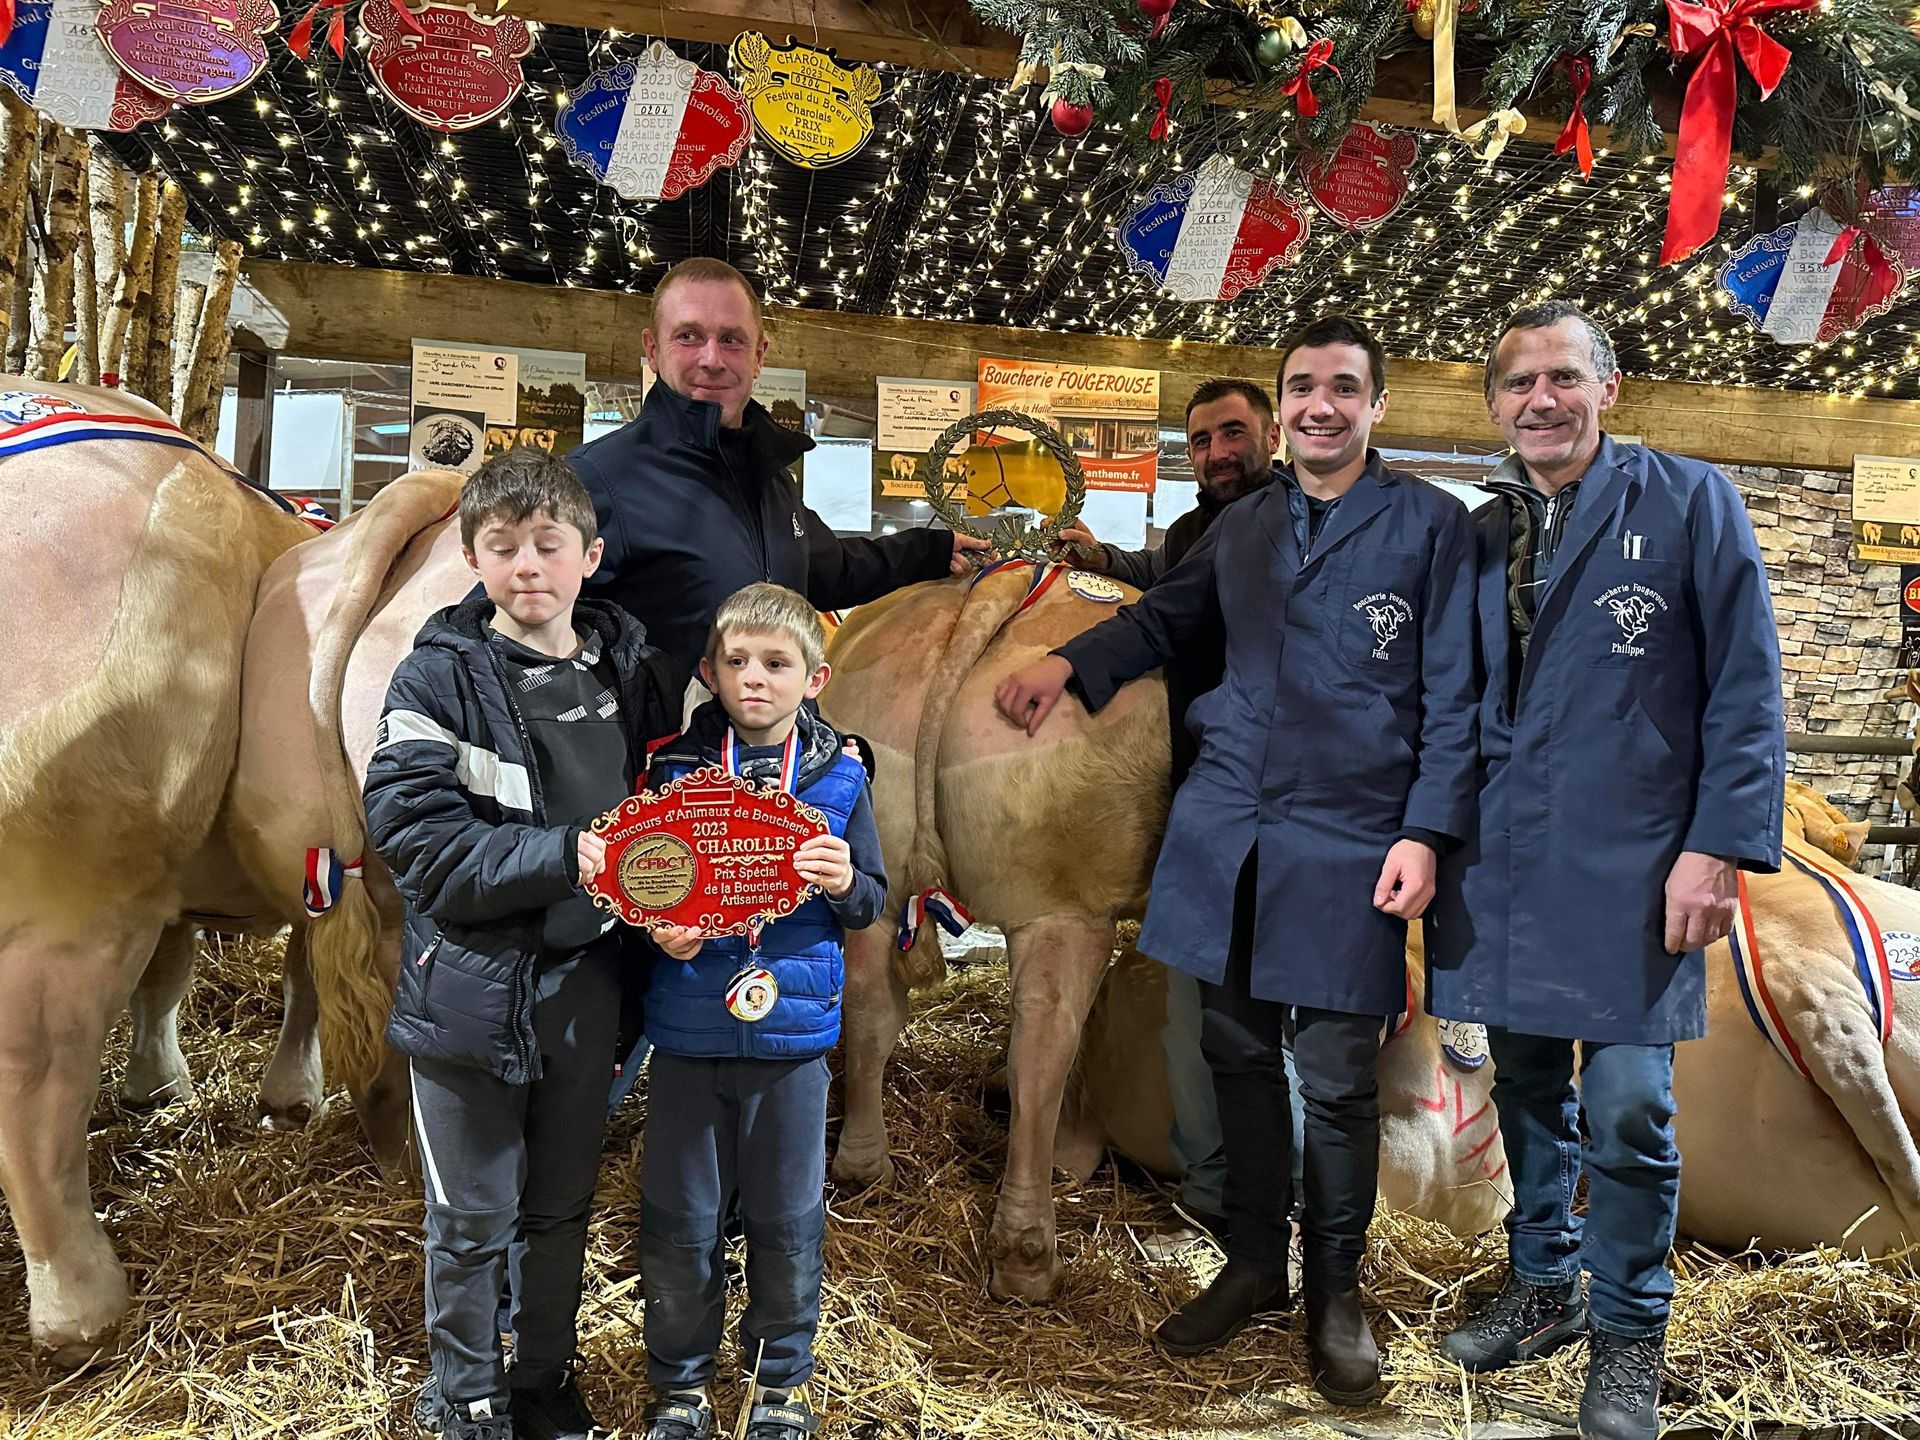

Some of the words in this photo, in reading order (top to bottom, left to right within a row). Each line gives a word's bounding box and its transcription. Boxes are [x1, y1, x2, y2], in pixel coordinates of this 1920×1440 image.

[415, 13, 489, 38] HAROLLES
[434, 25, 462, 37] 2023
[128, 19, 175, 34] Festival
[178, 23, 195, 34] du
[199, 26, 239, 52] Boeuf
[154, 32, 212, 51] Charolais
[135, 40, 160, 52] Prix
[398, 50, 440, 66] Festival
[442, 53, 458, 63] du
[461, 55, 496, 78] Boeuf
[420, 62, 473, 78] Charolais
[776, 53, 847, 82] CHAROLLES
[160, 67, 205, 84] BOEUF
[640, 73, 673, 86] 2023
[800, 66, 824, 79] 2023
[404, 72, 426, 84] Prix
[427, 75, 488, 91] d'Excellence
[795, 76, 821, 89] 0204
[397, 83, 444, 97] Médaille
[446, 87, 494, 104] d'Argent
[427, 98, 465, 111] BOEUF
[577, 94, 619, 126] Festival
[622, 91, 638, 103] du
[641, 88, 679, 101] Boeuf
[681, 92, 733, 129] Charolais
[640, 106, 669, 115] 0204
[765, 90, 803, 104] Festival
[806, 93, 819, 103] du
[822, 99, 853, 124] Boeuf
[785, 102, 832, 123] Charolais
[633, 118, 674, 129] BOEUF
[794, 117, 822, 133] PRIX
[619, 129, 660, 140] Médaille
[779, 125, 836, 148] NAISSEUR
[599, 140, 629, 151] Grand
[631, 140, 651, 151] Prix
[653, 140, 707, 152] d'Honneur
[611, 151, 693, 165] CHAROLLES
[1138, 206, 1178, 237] Festival
[1181, 202, 1195, 213] du
[1200, 199, 1237, 210] Boeuf
[1239, 202, 1289, 232] Charolais
[1159, 248, 1187, 259] Grand
[1190, 248, 1209, 258] Prix
[1211, 247, 1265, 258] d'Honneur
[1170, 257, 1251, 271] CHAROLLES
[1738, 255, 1780, 283] Festival
[1769, 303, 1848, 316] CHAROLLES
[983, 365, 1055, 388] Boucherie
[1057, 370, 1155, 394] FOUGEROUSE
[1022, 404, 1030, 413] la
[1031, 404, 1052, 413] Halle
[1352, 592, 1387, 611] Boucherie
[1593, 584, 1629, 607] Boucherie
[1633, 582, 1668, 611] Fougerouse
[1611, 642, 1645, 656] Philippe
[604, 817, 662, 846] Concours
[665, 807, 731, 824] d'Animaux
[733, 806, 749, 819] de
[752, 808, 811, 838] Boucherie
[692, 822, 728, 838] 2023
[696, 836, 796, 856] CHAROLLES
[636, 855, 689, 871] CFBCT
[714, 867, 736, 880] Prix
[738, 866, 778, 881] Spécial
[704, 883, 719, 895] de
[721, 882, 731, 894] la
[734, 879, 789, 894] Boucherie
[720, 893, 774, 906] Artisanale
